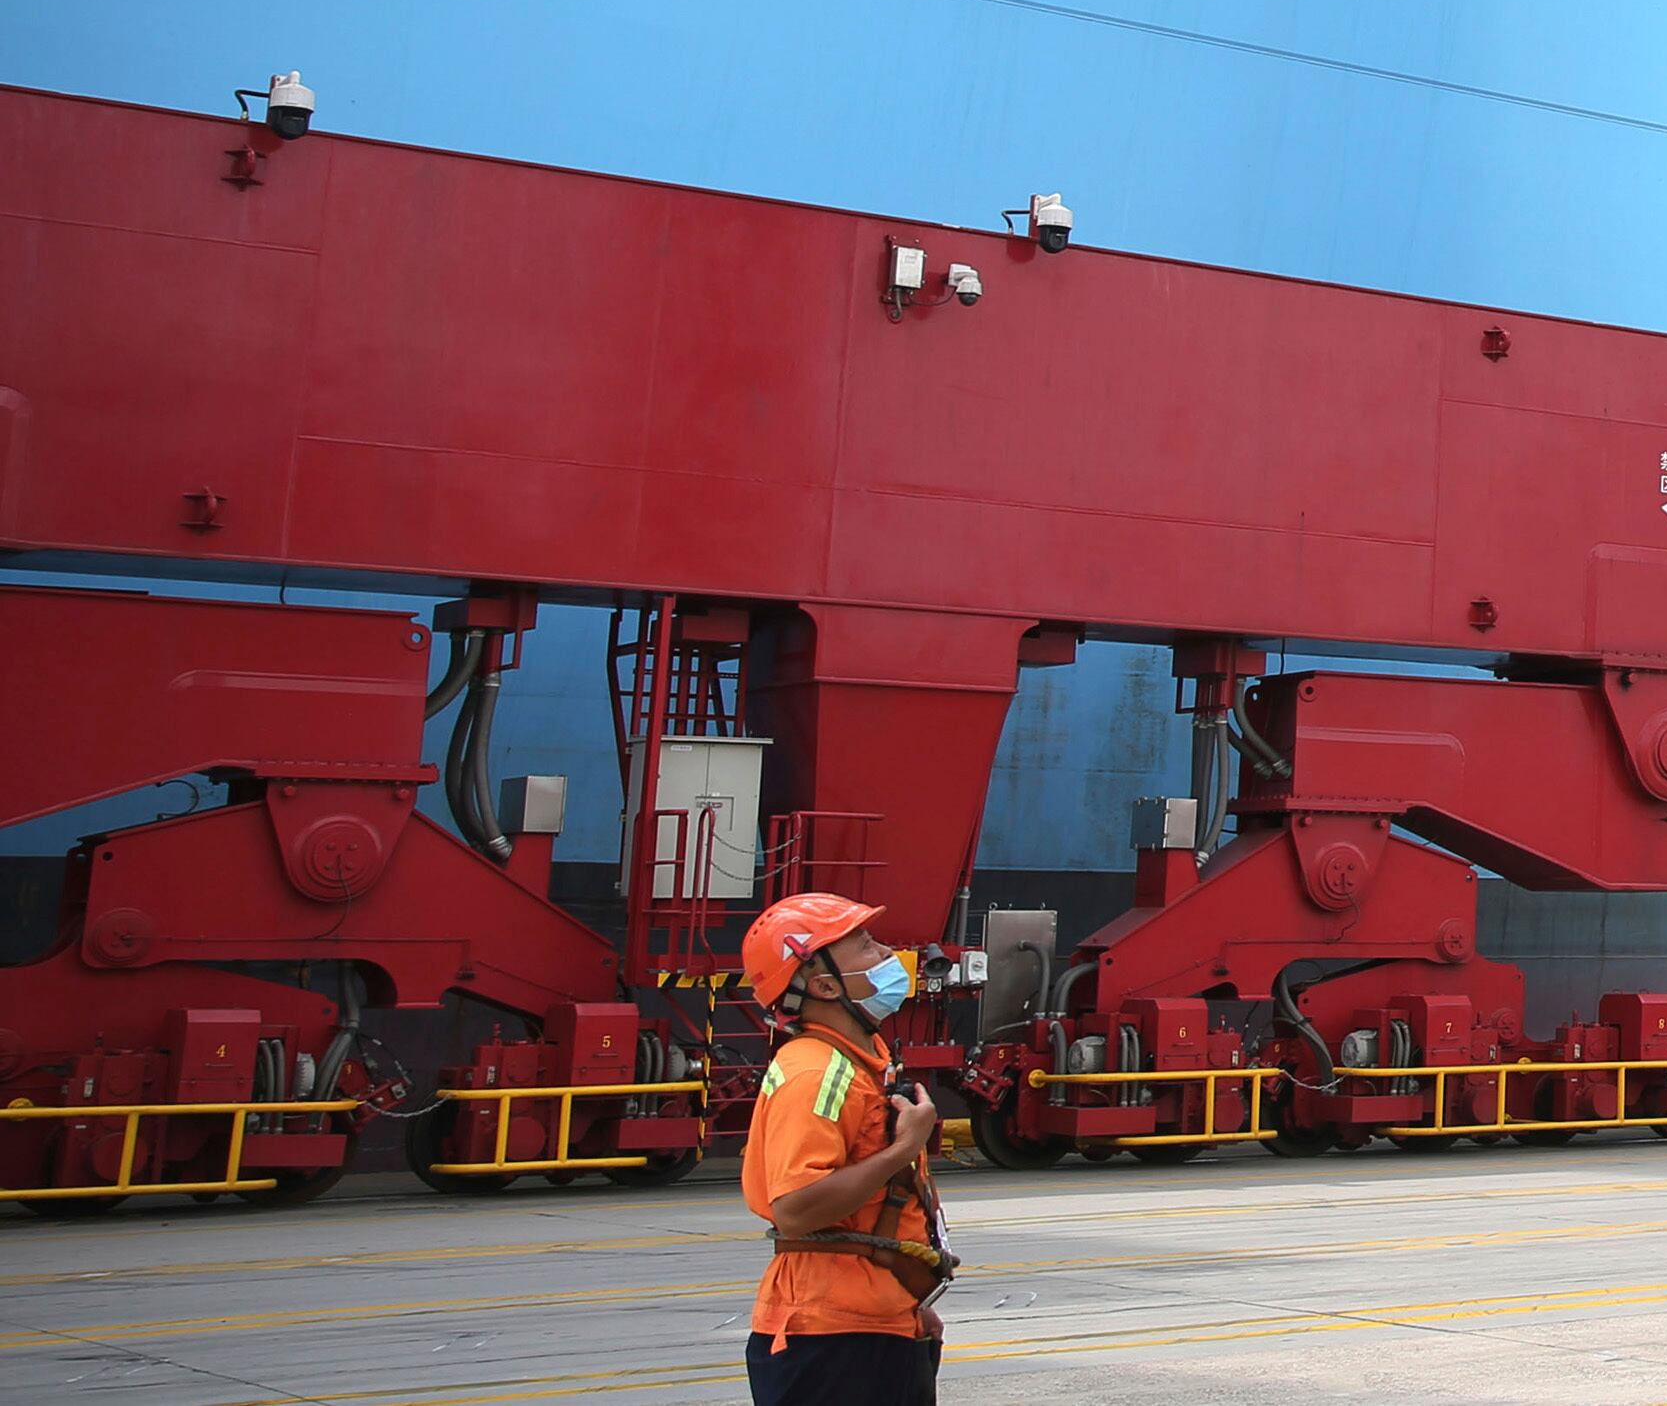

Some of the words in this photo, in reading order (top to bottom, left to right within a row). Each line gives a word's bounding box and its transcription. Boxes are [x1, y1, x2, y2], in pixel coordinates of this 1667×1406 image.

[1446, 1022, 1452, 1033] 7
[1658, 1018, 1665, 1030] 8
[1179, 1027, 1187, 1039] 6
[602, 1035, 611, 1048] 5
[216, 1044, 226, 1057] 4
